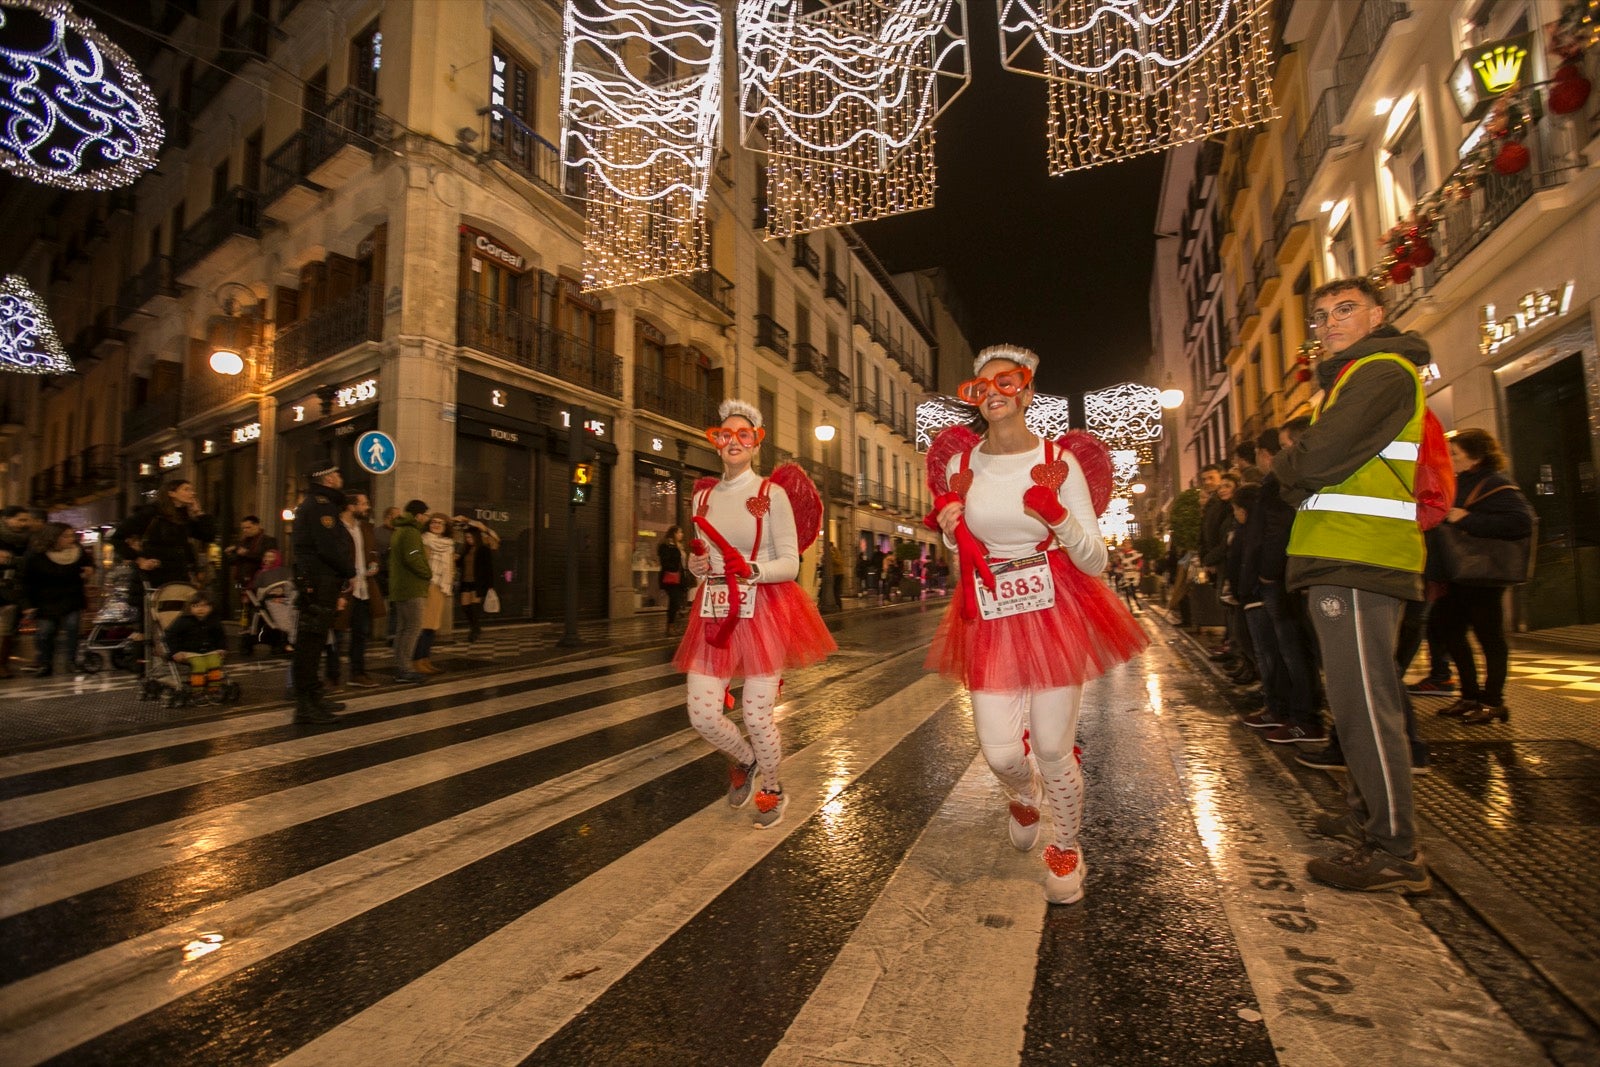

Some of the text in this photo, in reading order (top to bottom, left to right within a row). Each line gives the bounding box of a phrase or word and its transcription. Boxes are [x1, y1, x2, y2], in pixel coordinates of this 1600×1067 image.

[490, 428, 518, 442] TOUS
[475, 508, 509, 521] TOUS
[710, 591, 748, 605] 182
